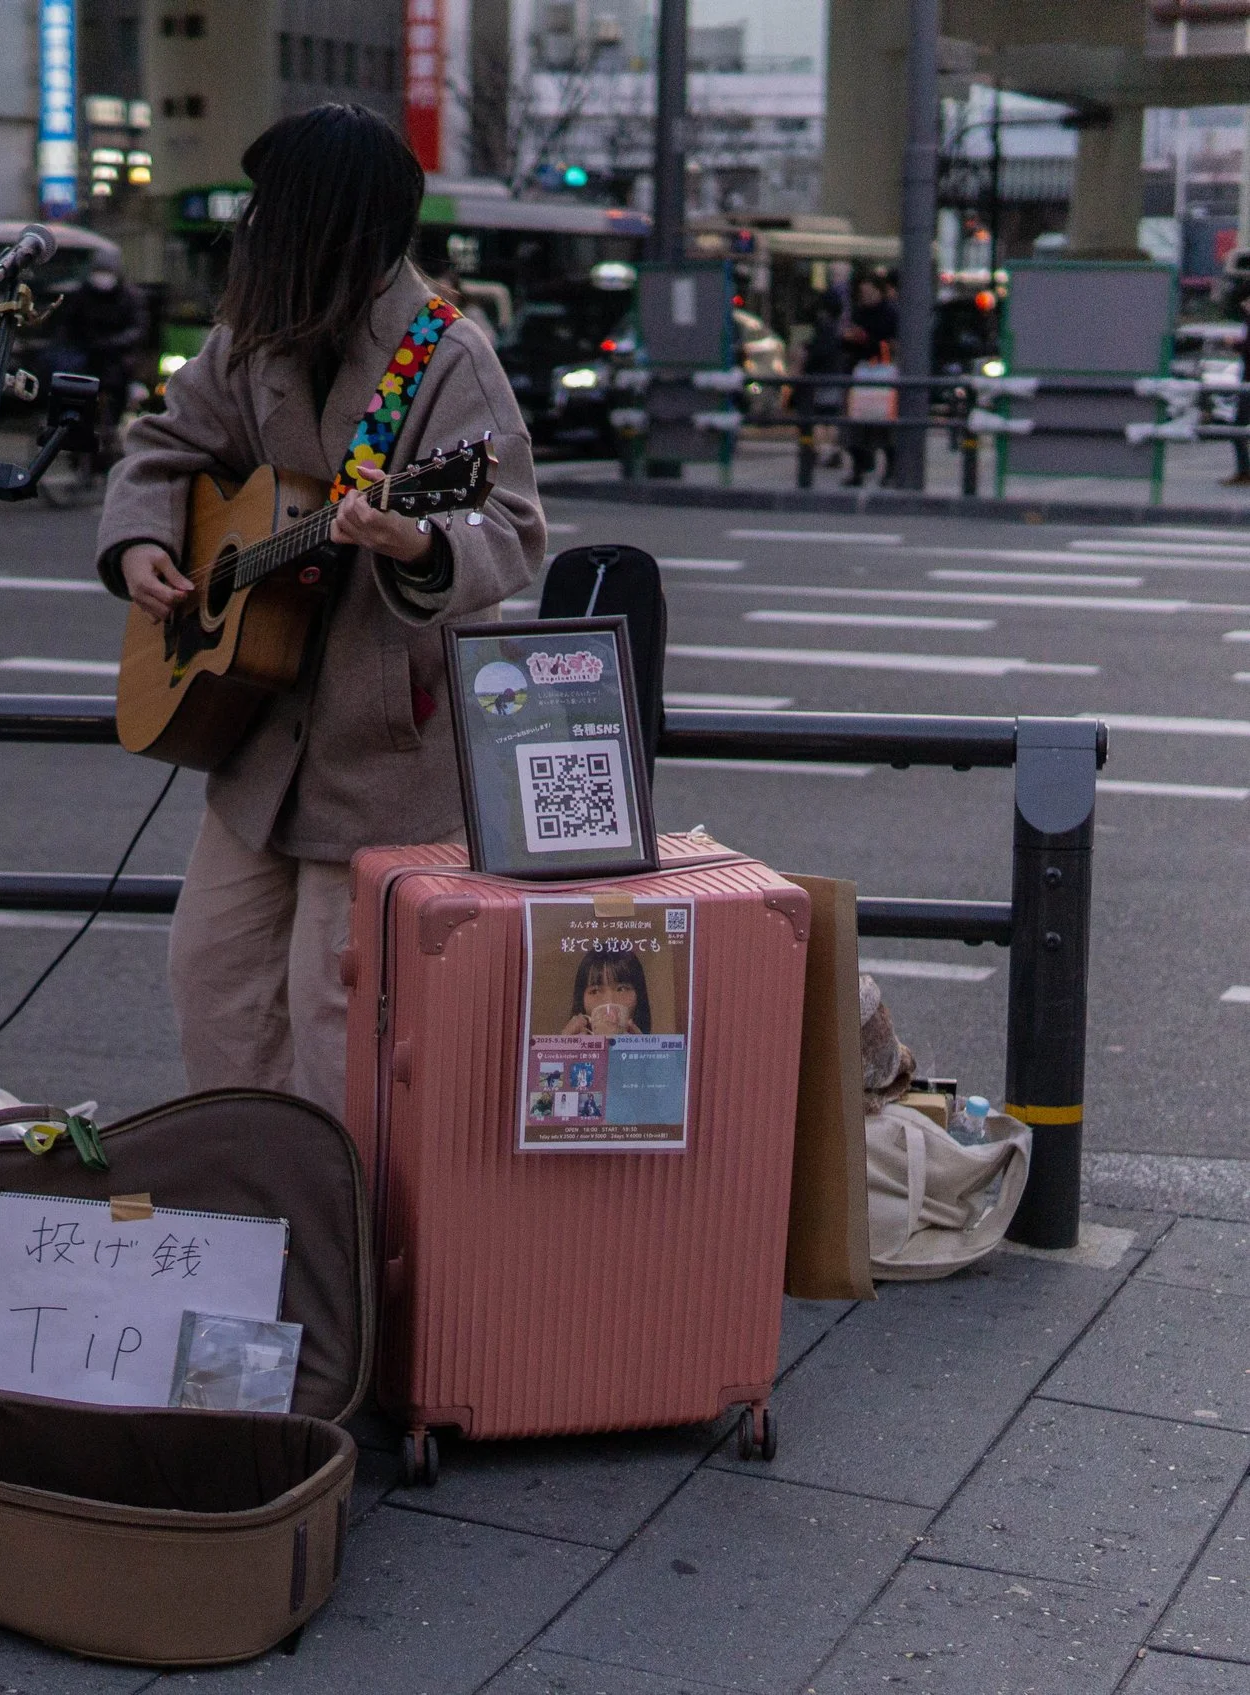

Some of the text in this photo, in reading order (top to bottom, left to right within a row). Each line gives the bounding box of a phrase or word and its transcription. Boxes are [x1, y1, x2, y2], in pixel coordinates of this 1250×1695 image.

[470, 458, 480, 487] Taylor
[572, 723, 621, 737] 各種SNS
[561, 936, 662, 953] 寝ても覚めても
[25, 1216, 211, 1280] 投げ銭
